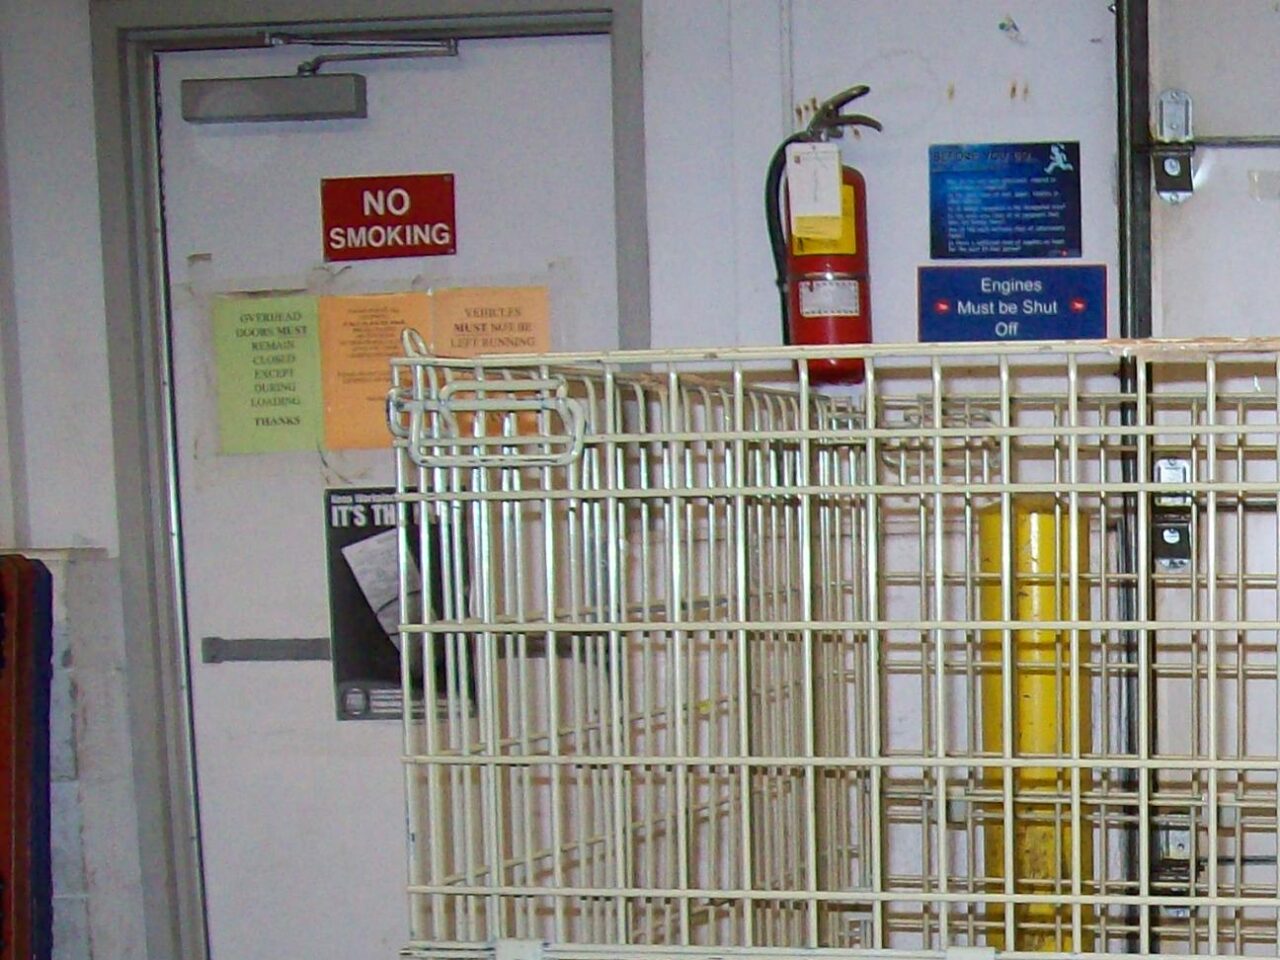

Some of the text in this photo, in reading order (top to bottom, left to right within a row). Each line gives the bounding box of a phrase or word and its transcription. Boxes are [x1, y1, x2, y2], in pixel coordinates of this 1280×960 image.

[363, 188, 411, 216] NO
[329, 223, 451, 249] SMOKING
[981, 278, 1043, 295] Engines
[464, 307, 522, 318] VEHICLES
[957, 300, 1058, 315] Must be Shut
[277, 325, 307, 335] MUST
[454, 323, 487, 332] MUST
[995, 322, 1019, 336] Off
[450, 337, 536, 348] LEFT RUNNING
[255, 416, 301, 426] THANKS
[331, 503, 367, 527] IT'S
[370, 503, 397, 526] TH
